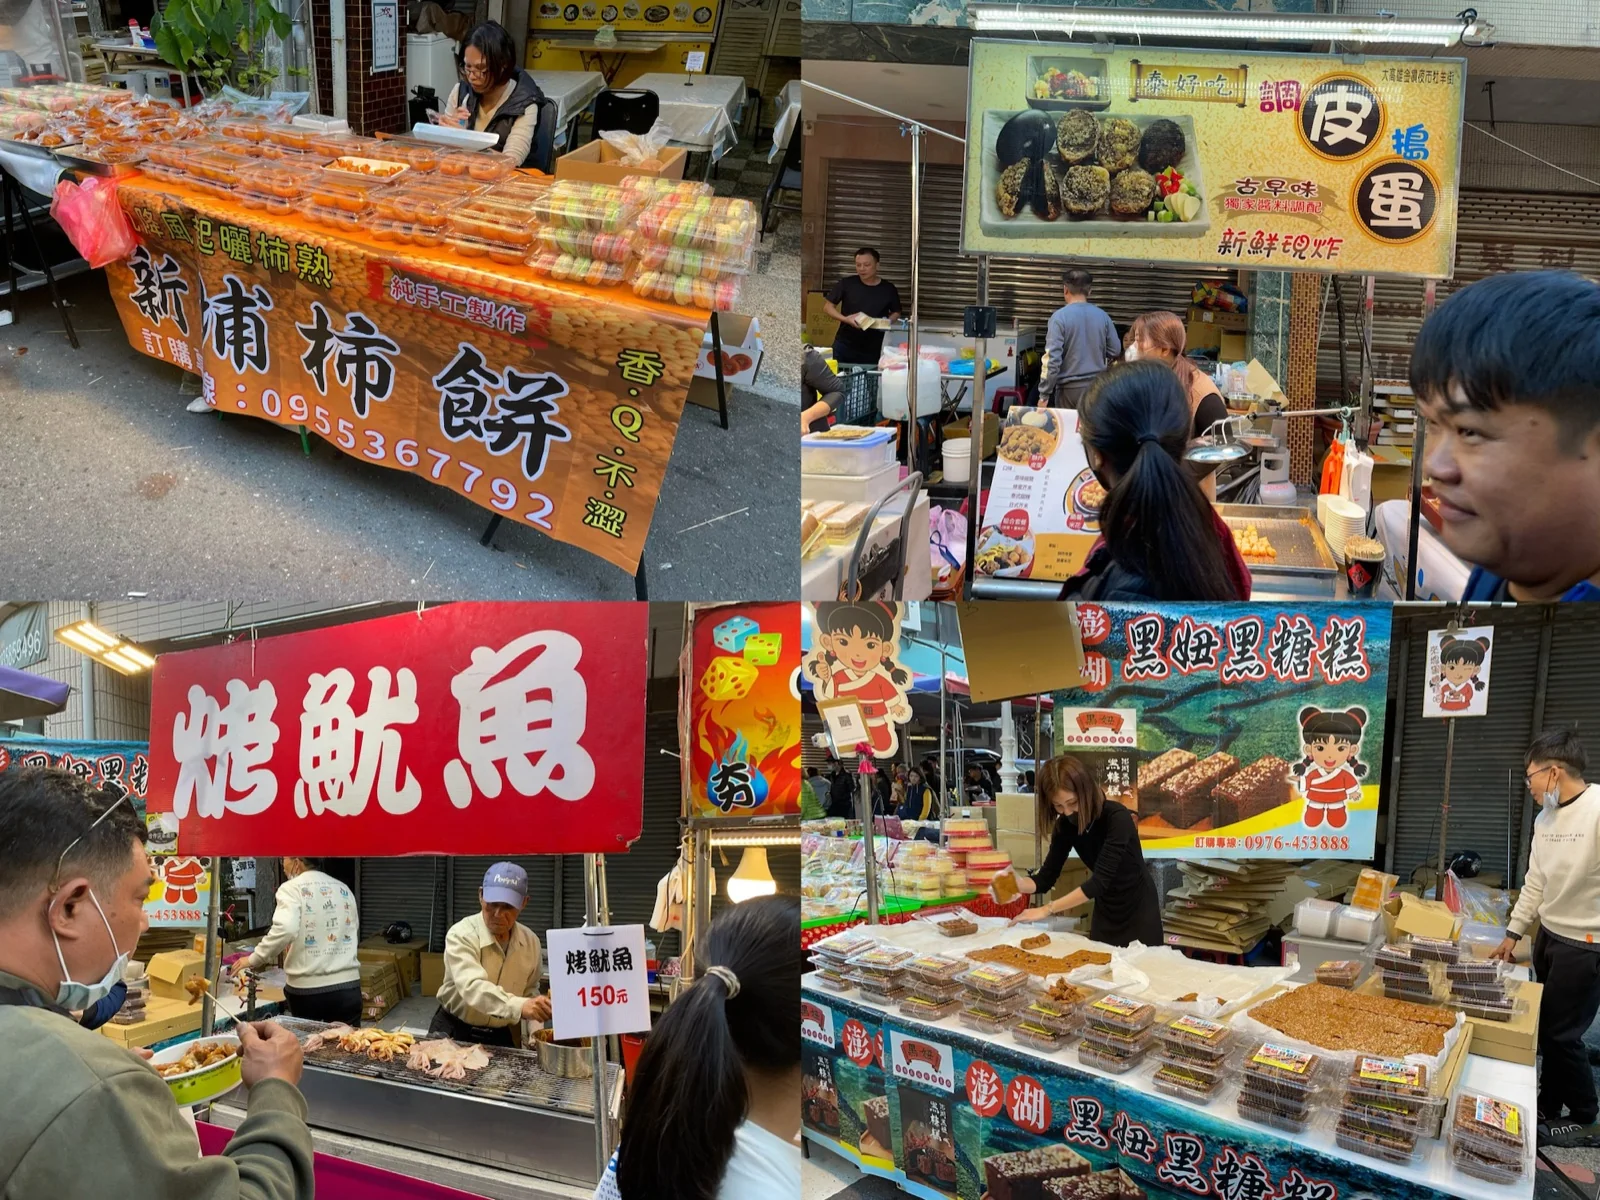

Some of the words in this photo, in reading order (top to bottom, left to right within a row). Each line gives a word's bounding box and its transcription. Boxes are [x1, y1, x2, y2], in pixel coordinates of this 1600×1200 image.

[1144, 70, 1232, 96] 泰好吃
[1235, 178, 1318, 198] 古早味
[1224, 197, 1322, 214] 獨家醬料調配
[1217, 227, 1343, 260] 新鮮現炸
[390, 276, 526, 335] 純手工製作
[1125, 618, 1366, 680] 黑妞黑糖糕
[173, 630, 596, 819] 烤魷魚
[711, 761, 755, 813] 夯
[145, 909, 201, 921] -453888
[566, 946, 633, 975] 烤魷魚
[577, 985, 628, 1007] 150元
[970, 1065, 1046, 1130] 澎湖
